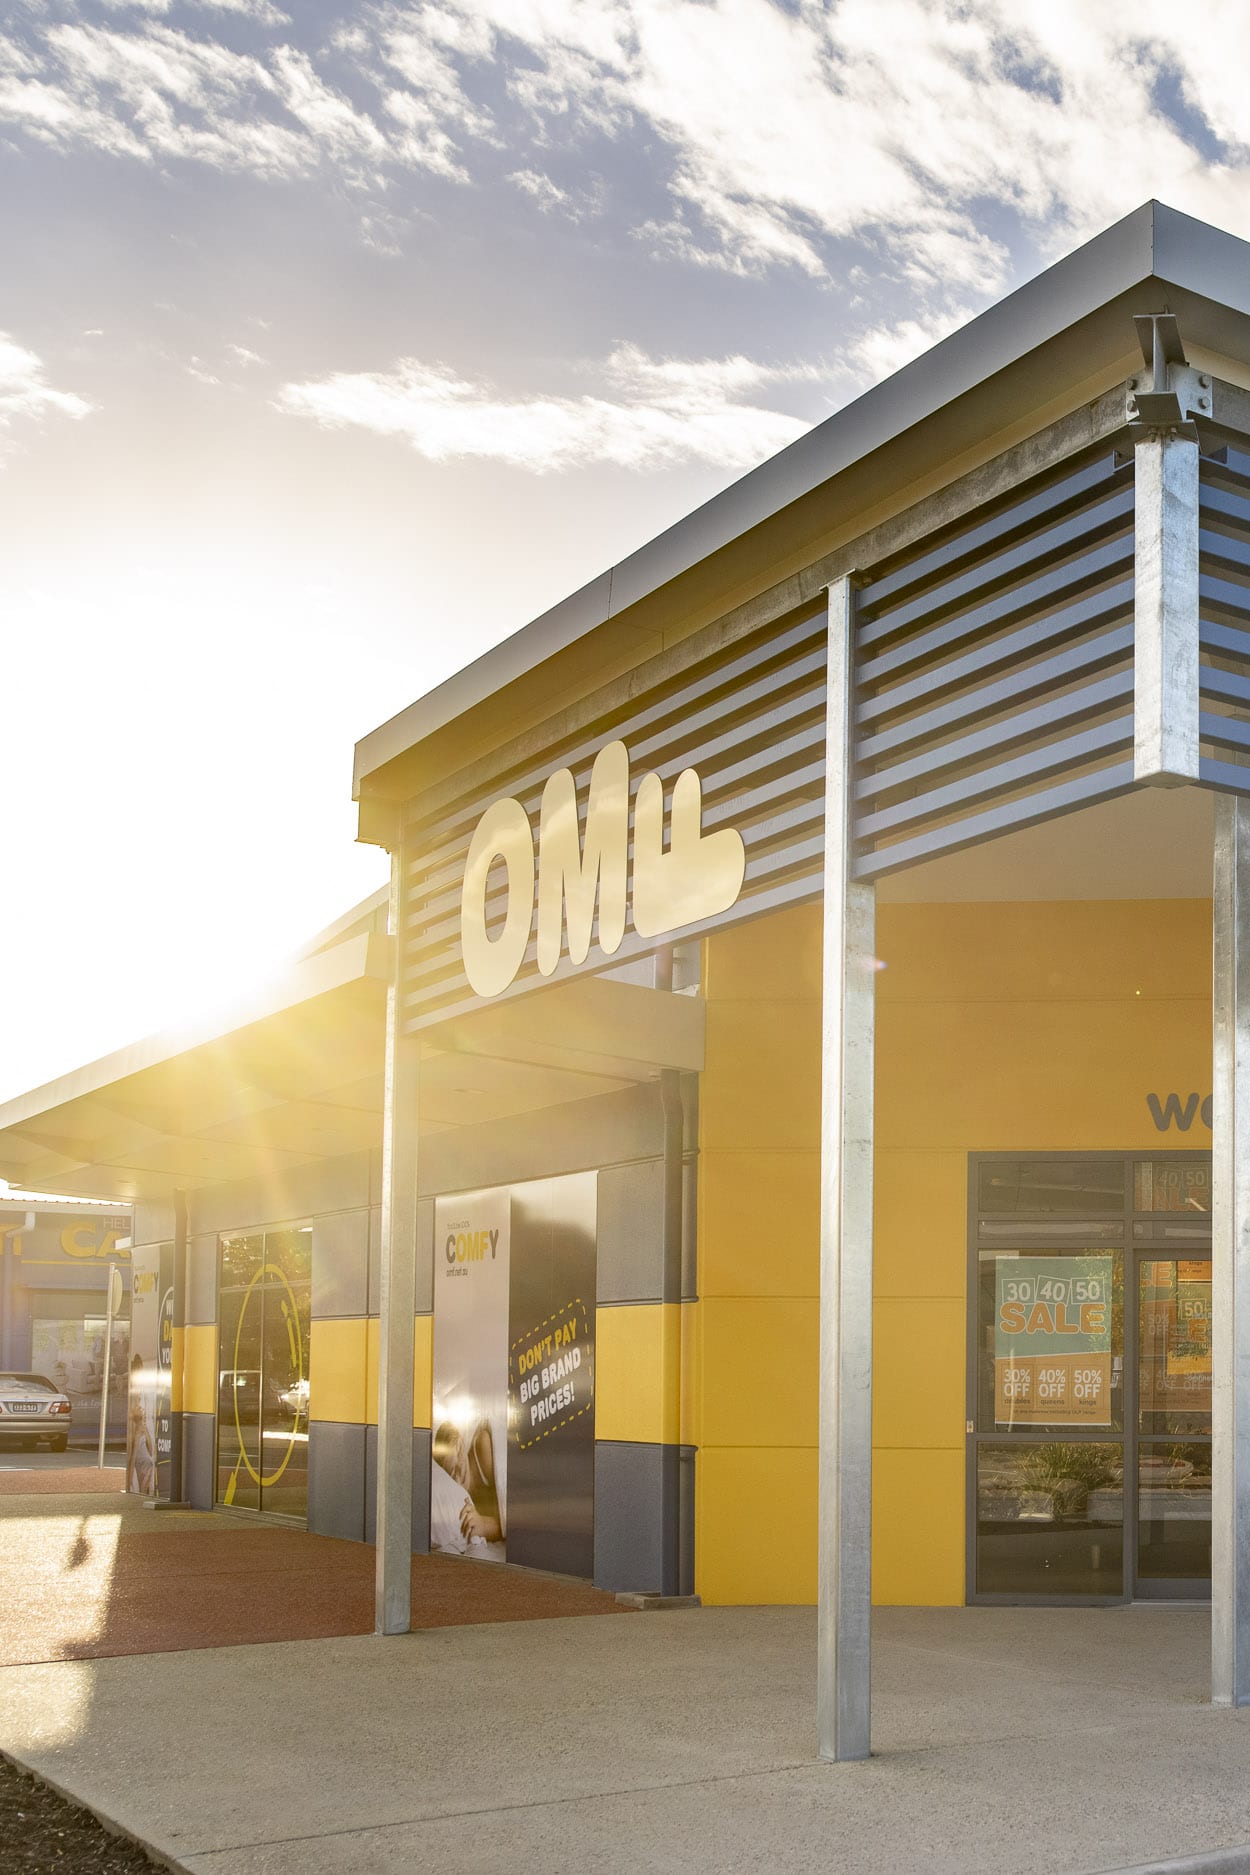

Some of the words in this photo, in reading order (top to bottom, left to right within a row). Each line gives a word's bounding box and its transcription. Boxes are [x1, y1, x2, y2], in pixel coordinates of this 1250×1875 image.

[103, 1217, 130, 1231] HEL
[61, 1222, 131, 1259] CA
[446, 1229, 499, 1264] COMFY
[1007, 1282, 1031, 1301] 30
[1040, 1280, 1066, 1301] 40
[1076, 1280, 1100, 1301] 50
[1185, 1301, 1204, 1318] 50
[1000, 1301, 1107, 1335] SALE
[519, 1335, 552, 1375] DON'T
[554, 1317, 577, 1351] PAY
[520, 1374, 540, 1404] BIG
[541, 1347, 581, 1390] BRAND
[1004, 1369, 1031, 1384] 30%
[1038, 1369, 1066, 1384] 40%
[1074, 1369, 1102, 1384] 50%
[1004, 1384, 1030, 1397] OFF
[1039, 1384, 1065, 1397] OFF
[1074, 1384, 1101, 1398] OFF
[530, 1381, 575, 1426] PRICES!
[158, 1438, 172, 1453] COMP
